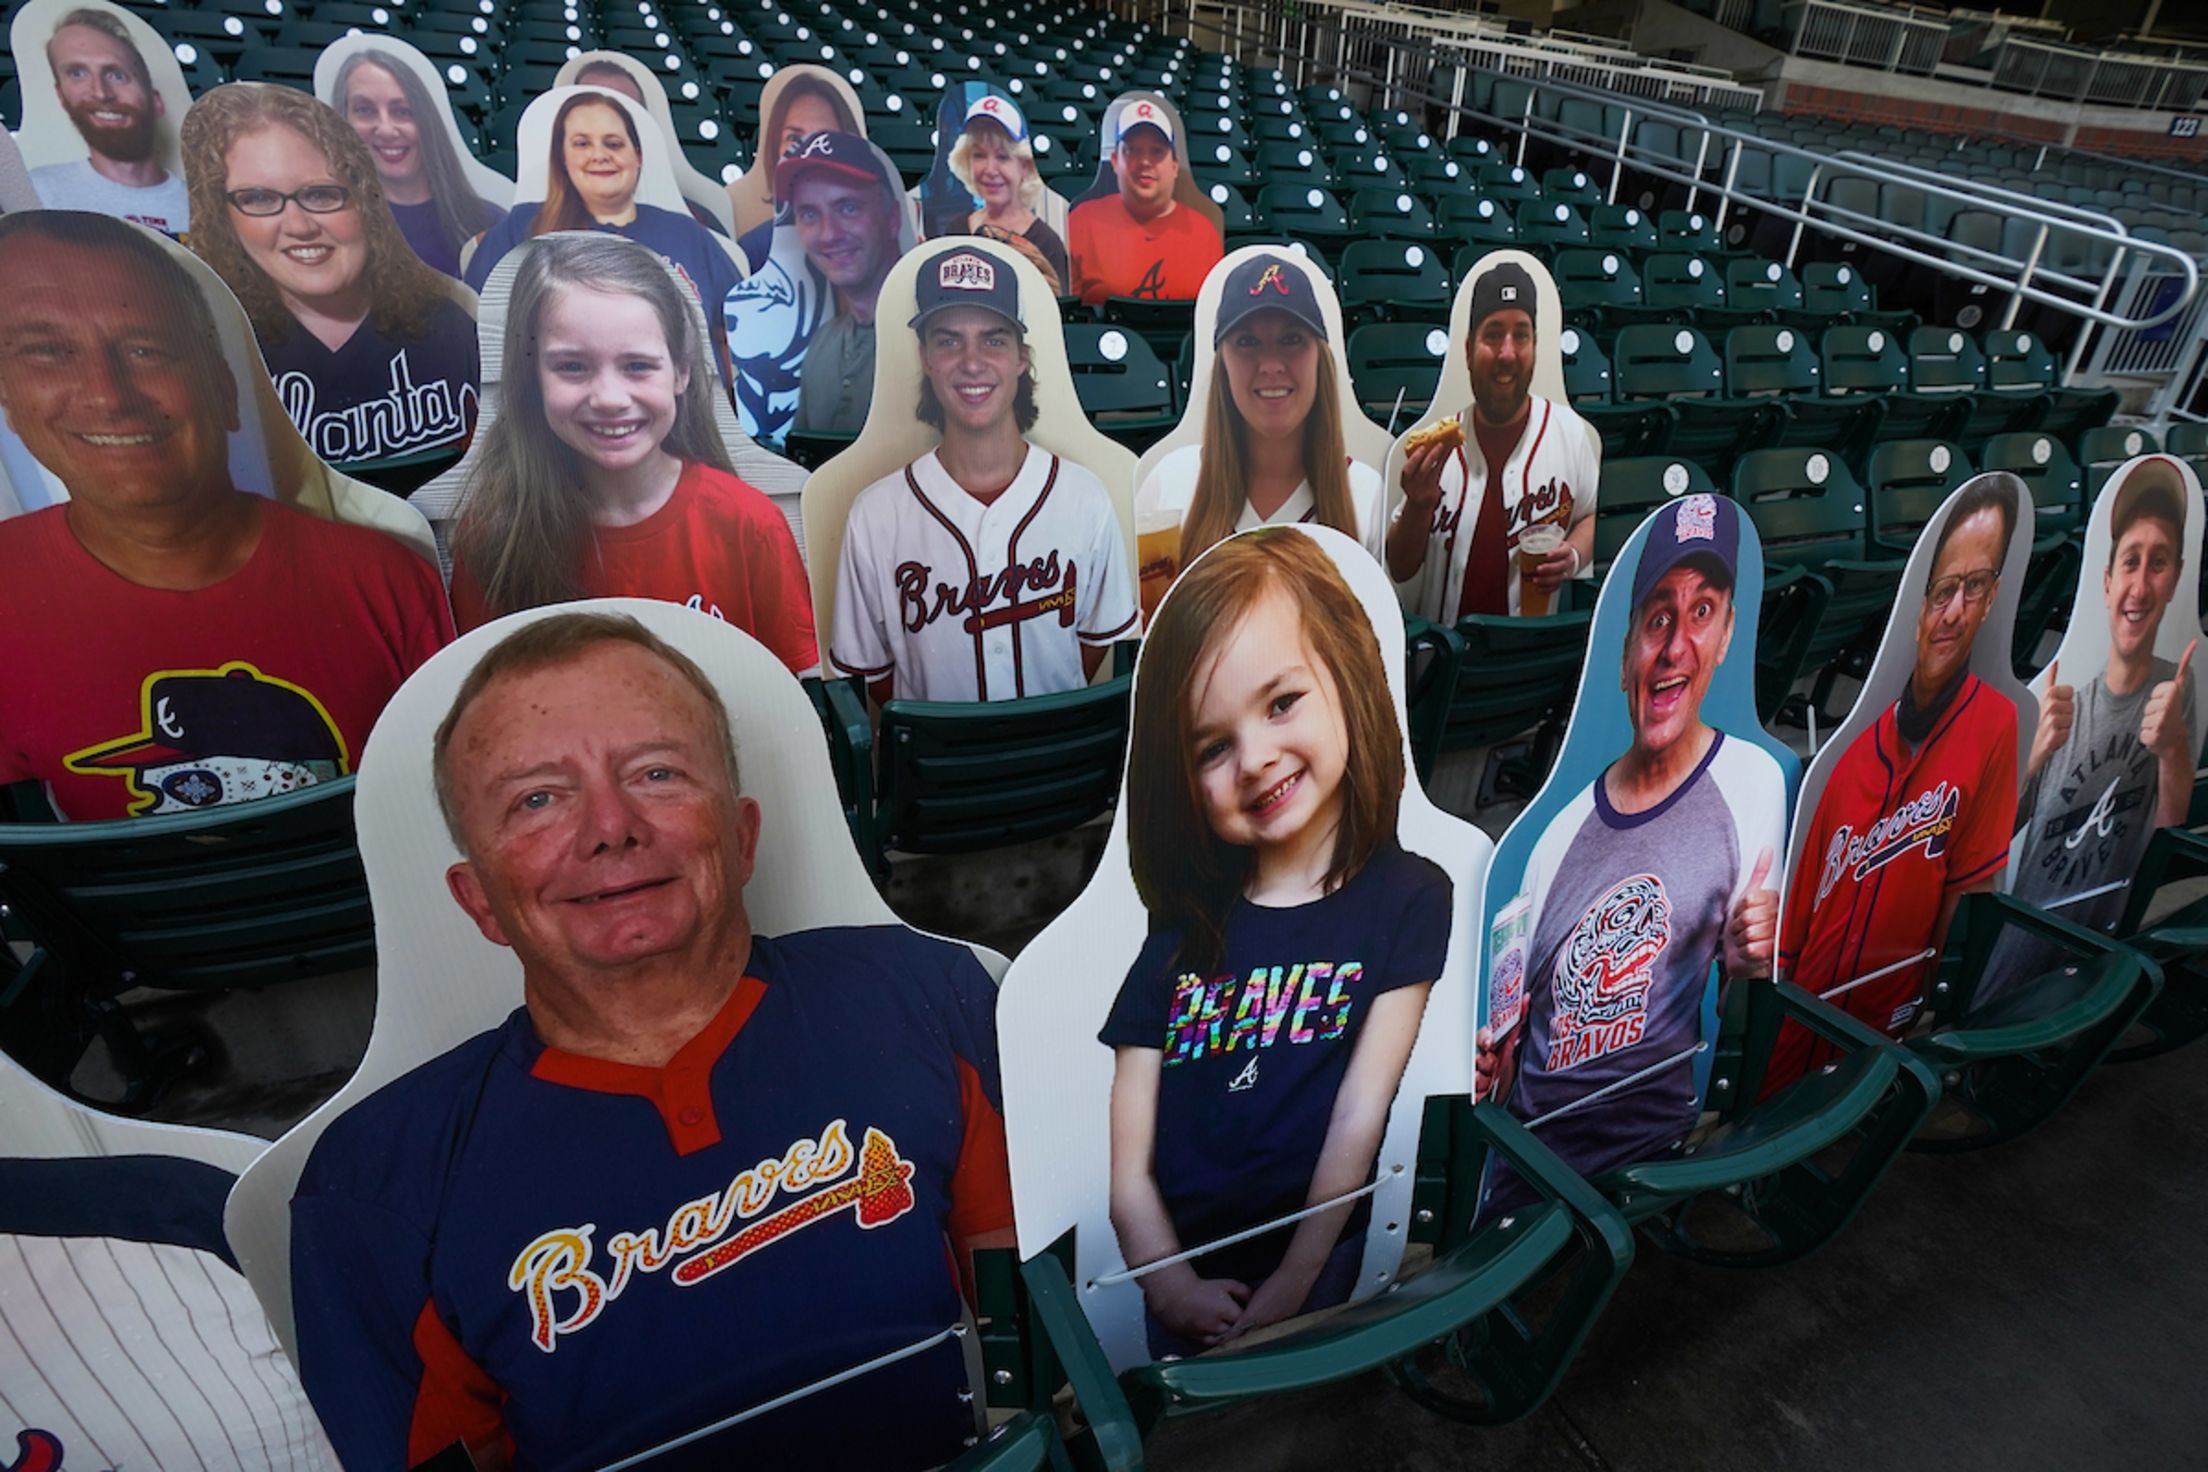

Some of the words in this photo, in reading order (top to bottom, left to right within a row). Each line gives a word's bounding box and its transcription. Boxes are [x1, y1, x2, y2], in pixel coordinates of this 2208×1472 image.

[2170, 118, 2199, 137] 123
[272, 348, 460, 462] lanta
[894, 548, 1061, 634] Braves
[1813, 780, 1948, 914] Braves
[1163, 961, 1365, 1068] BRAVES
[1546, 1013, 1647, 1073] BRAVOS
[508, 1118, 855, 1354] Braves
